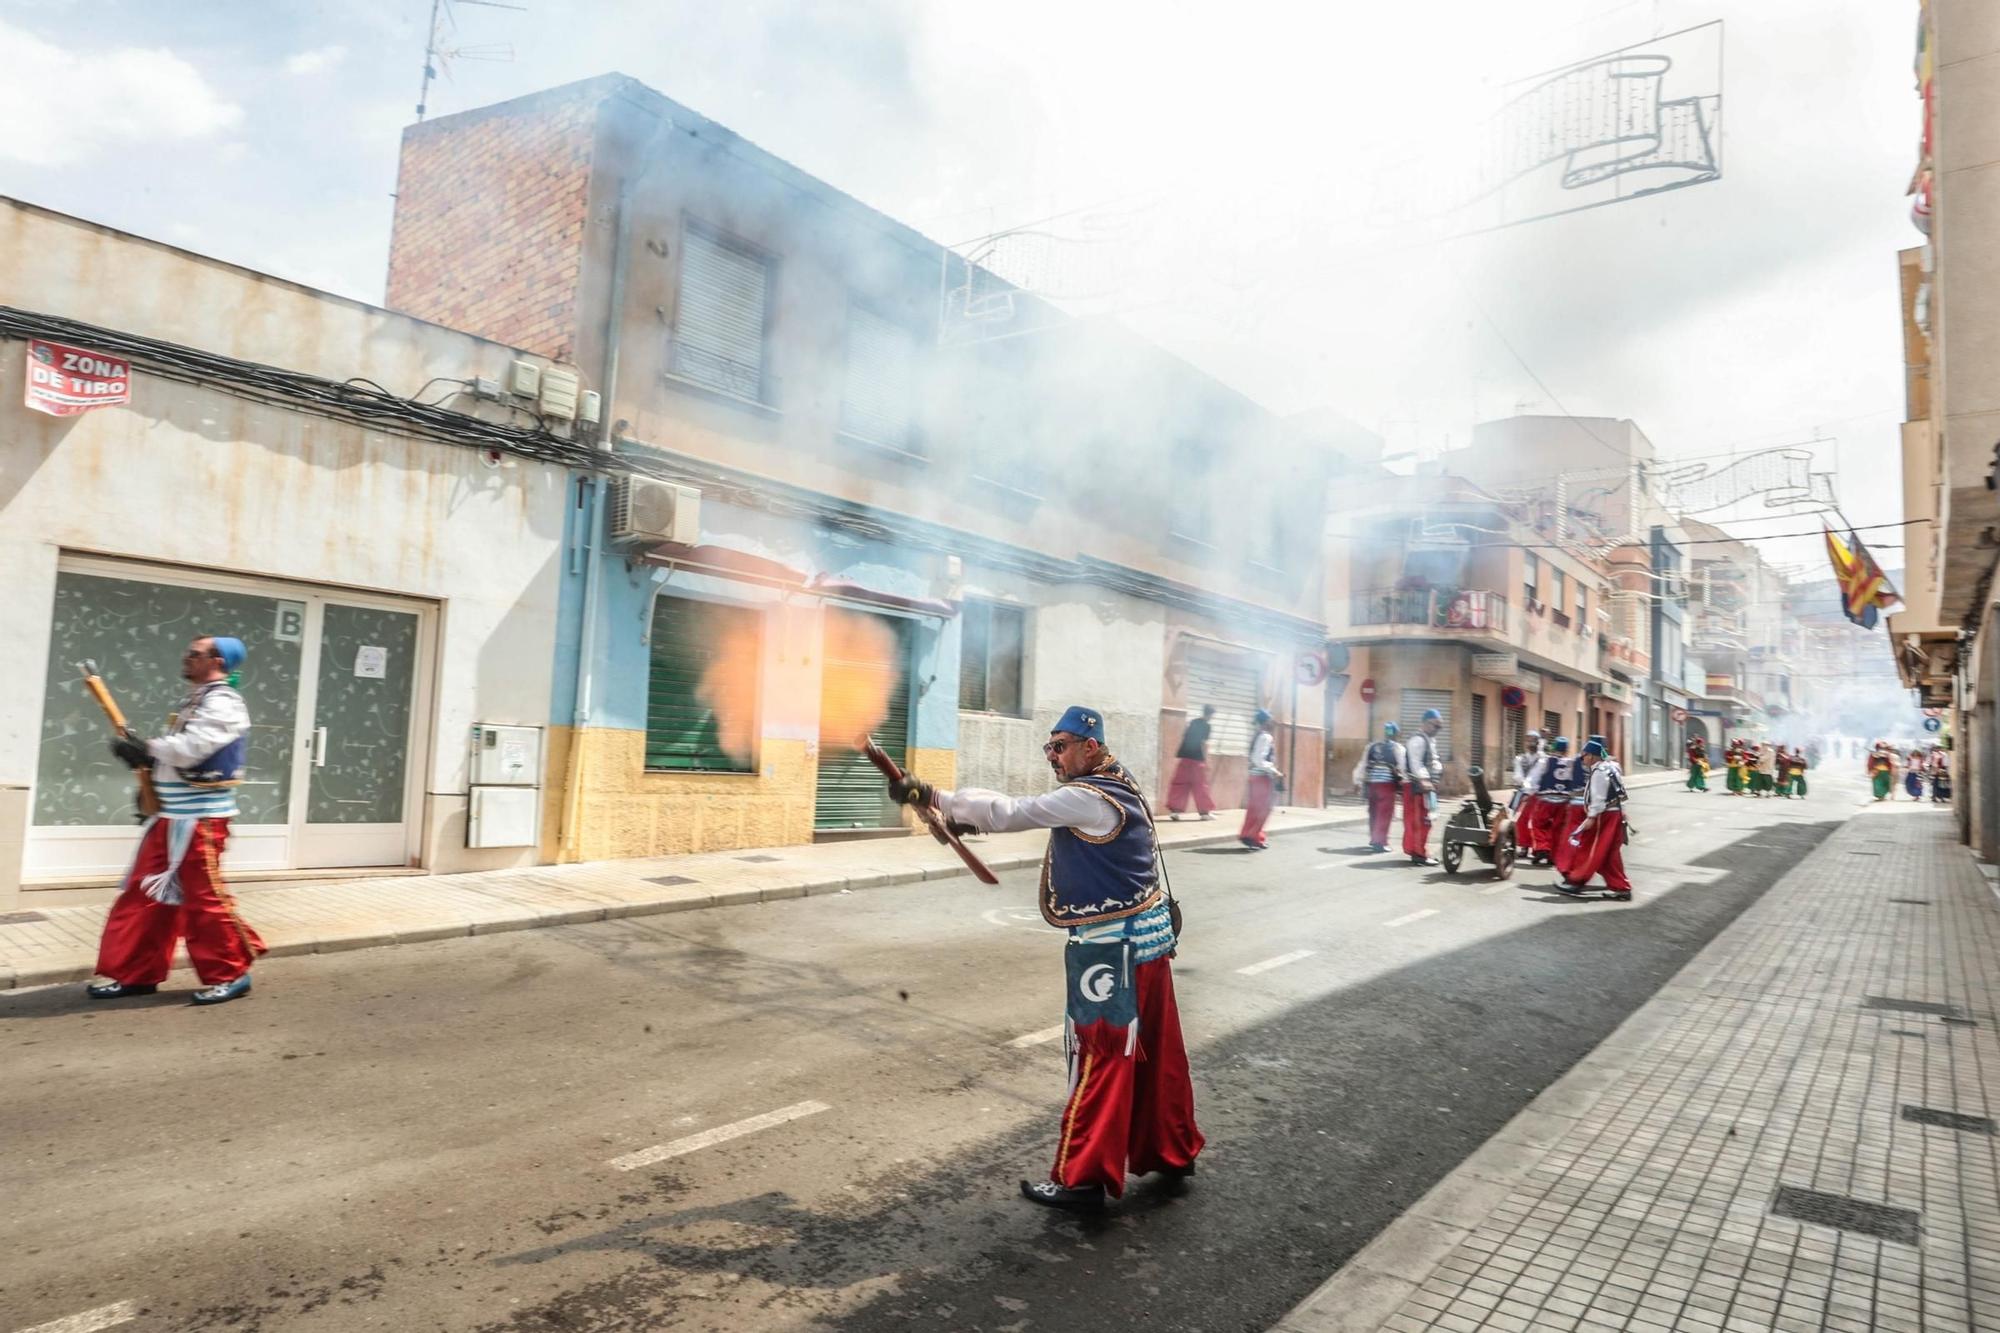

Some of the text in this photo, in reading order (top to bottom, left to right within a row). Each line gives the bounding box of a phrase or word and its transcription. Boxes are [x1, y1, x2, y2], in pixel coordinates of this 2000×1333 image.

[62, 353, 126, 377] ZONA
[33, 367, 126, 394] DE TIRO
[281, 611, 300, 636] B
